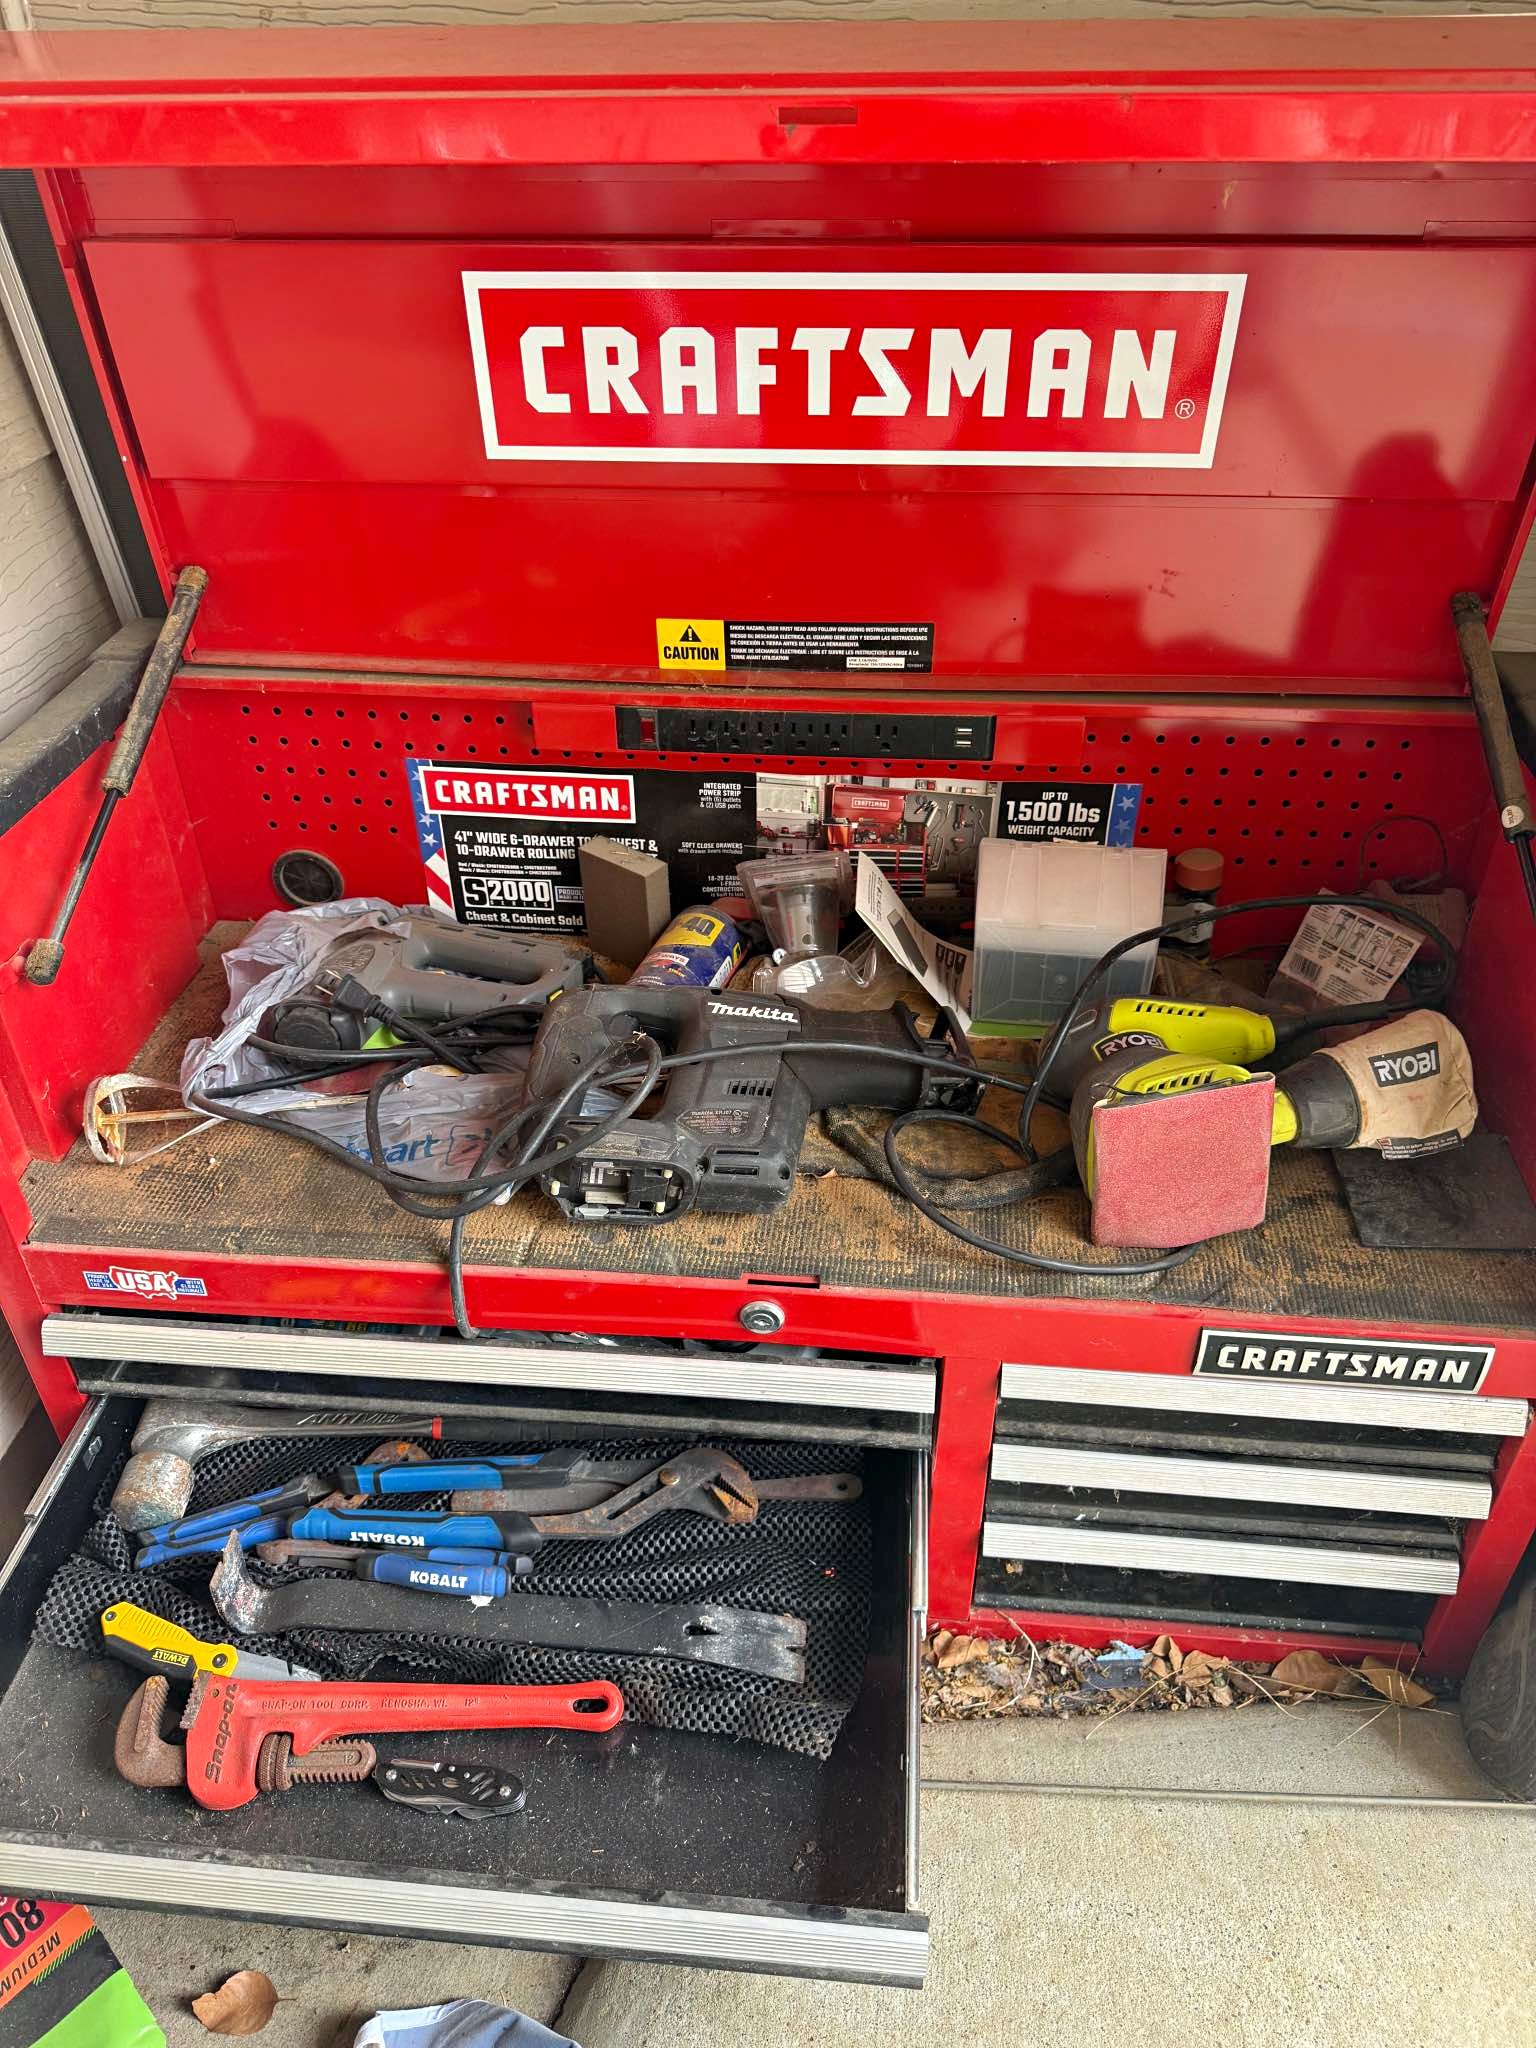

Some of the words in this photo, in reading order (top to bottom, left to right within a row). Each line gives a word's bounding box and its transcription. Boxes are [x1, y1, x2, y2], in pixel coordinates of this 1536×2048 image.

[519, 326, 1177, 420] CRAFTSMAN
[662, 645, 720, 661] CAUTION
[434, 778, 620, 812] CRAFTSMAN
[1042, 791, 1055, 800] UP
[1057, 792, 1068, 800] TO
[1006, 800, 1062, 823] 1,500
[1067, 803, 1101, 823] lbs
[454, 830, 473, 843] 41"
[475, 831, 508, 845] WIDE
[509, 833, 575, 847] 6-DRAWER
[648, 839, 658, 852] &
[1007, 825, 1046, 835] WEIGHT
[1047, 826, 1095, 837] CAPACITY
[455, 843, 525, 859] 10-DRAWER
[527, 847, 576, 860] ROLLING
[465, 911, 498, 922] Chest
[500, 912, 511, 923] &
[512, 913, 556, 925] Cabinet
[557, 915, 584, 926] Sold
[707, 1001, 798, 1023] makita
[1374, 1048, 1437, 1082] RYOBI
[116, 1271, 173, 1292] USA
[1216, 1344, 1471, 1385] CRAFTSMAN
[350, 1531, 425, 1546] KOBALT
[410, 1570, 469, 1588] KOBALT
[0, 1898, 45, 1949] 80
[0, 1931, 61, 1998] MEDIUM
